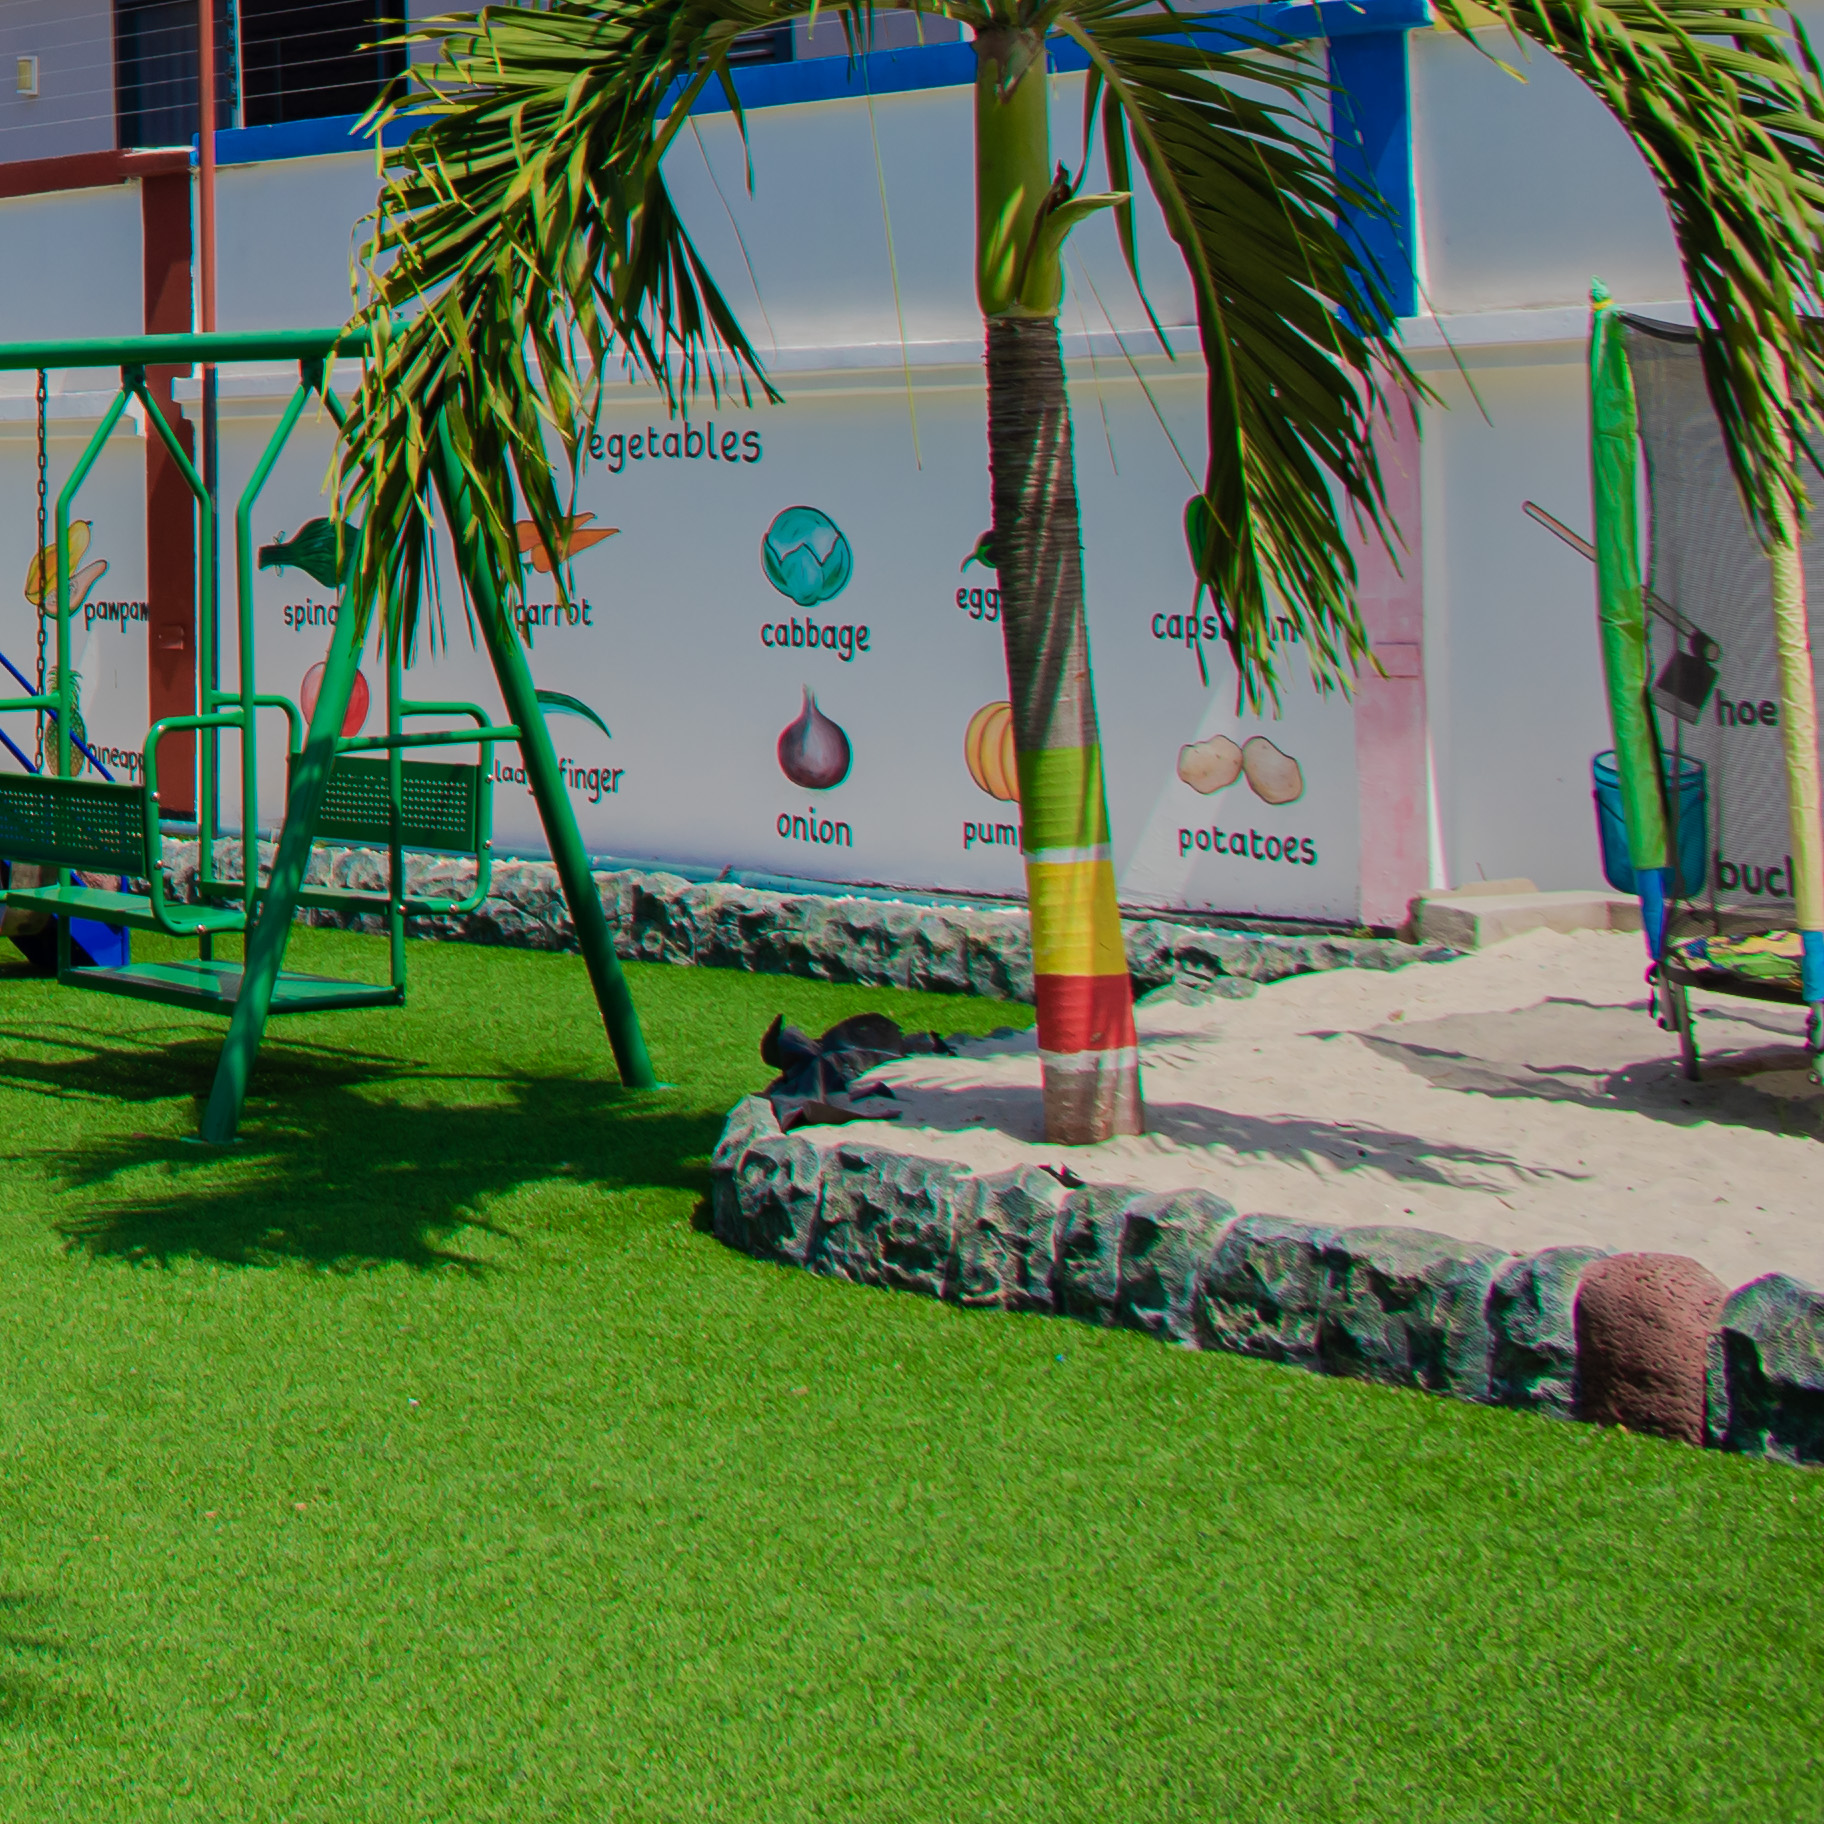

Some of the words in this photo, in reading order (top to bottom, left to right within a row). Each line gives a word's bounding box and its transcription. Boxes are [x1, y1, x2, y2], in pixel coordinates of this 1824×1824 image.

[283, 598, 339, 631] spina
[956, 587, 1000, 622] egg
[760, 616, 871, 662] cabbage
[1714, 688, 1779, 726] hoe
[86, 742, 144, 786] pineapp
[776, 806, 853, 848] onion
[1178, 826, 1319, 866] potatoes
